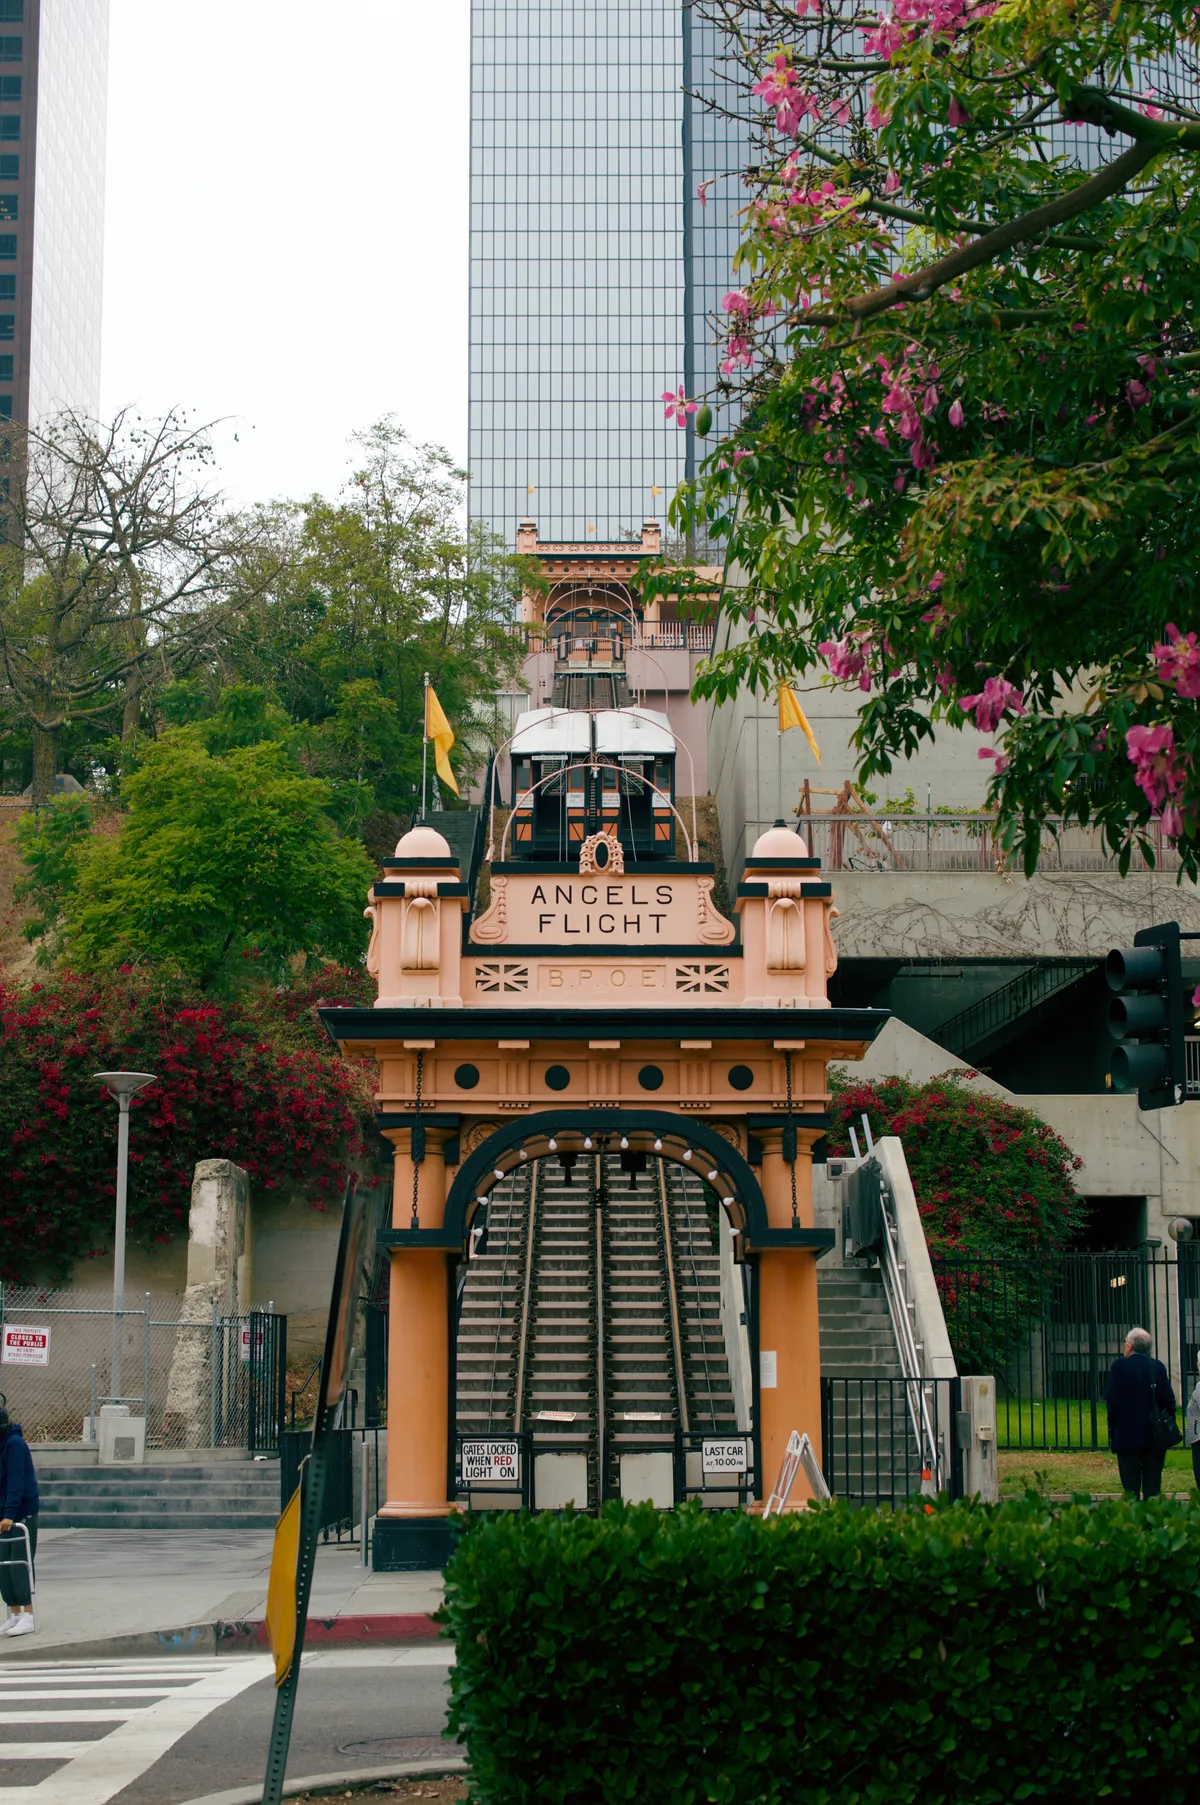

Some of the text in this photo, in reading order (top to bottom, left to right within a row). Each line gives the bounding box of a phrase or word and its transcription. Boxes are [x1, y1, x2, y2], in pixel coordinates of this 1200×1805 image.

[531, 885, 673, 905] ANGELS
[538, 914, 667, 933] FLIGHT
[463, 1444, 517, 1455] GATES LOCKED
[705, 1446, 743, 1456] LAST CAR
[467, 1456, 512, 1466] WHEN RED
[714, 1458, 736, 1466] 10:00
[466, 1467, 515, 1478] LIGHT ON
